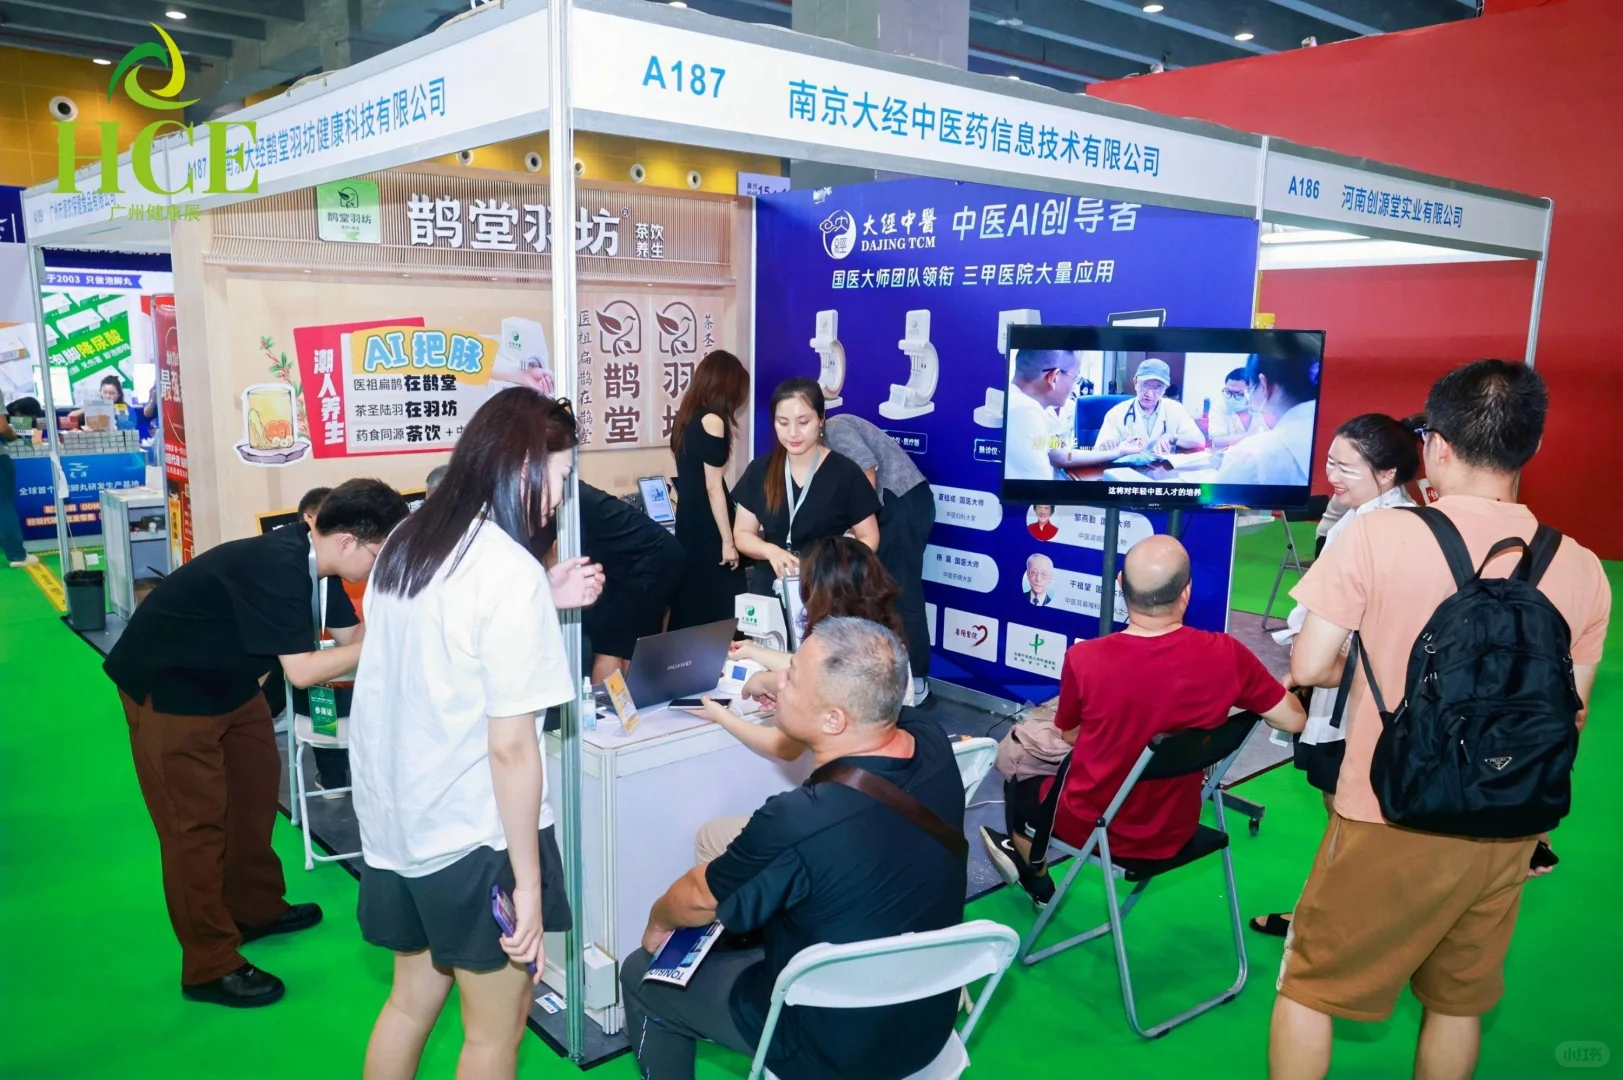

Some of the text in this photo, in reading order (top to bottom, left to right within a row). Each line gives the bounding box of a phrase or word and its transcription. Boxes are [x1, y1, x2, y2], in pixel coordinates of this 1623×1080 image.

[643, 55, 1160, 176] A187 南京大经中医药信息技术有限公司
[1288, 175, 1463, 228] A186 河南创源堂实业有限公司
[327, 212, 372, 224] 鹊堂羽坊
[952, 197, 1143, 241] 中医AI创导者
[635, 223, 664, 241] 茶饮
[860, 236, 936, 251] DAJING TCM
[635, 241, 664, 259] 养生
[831, 260, 1115, 289] 国医大师团队领衔 三甲医院大量应用
[364, 330, 485, 374] AI把脉
[577, 309, 592, 445] 医祖扁鹊在鹊堂
[313, 349, 345, 445] 潮人养生
[603, 361, 641, 444] 鹊堂
[959, 496, 985, 506] 国医大师
[1108, 487, 1202, 497] 这将对年轻中医人才的培养
[954, 557, 979, 569] 国医大师
[667, 660, 692, 671] HUAWEI
